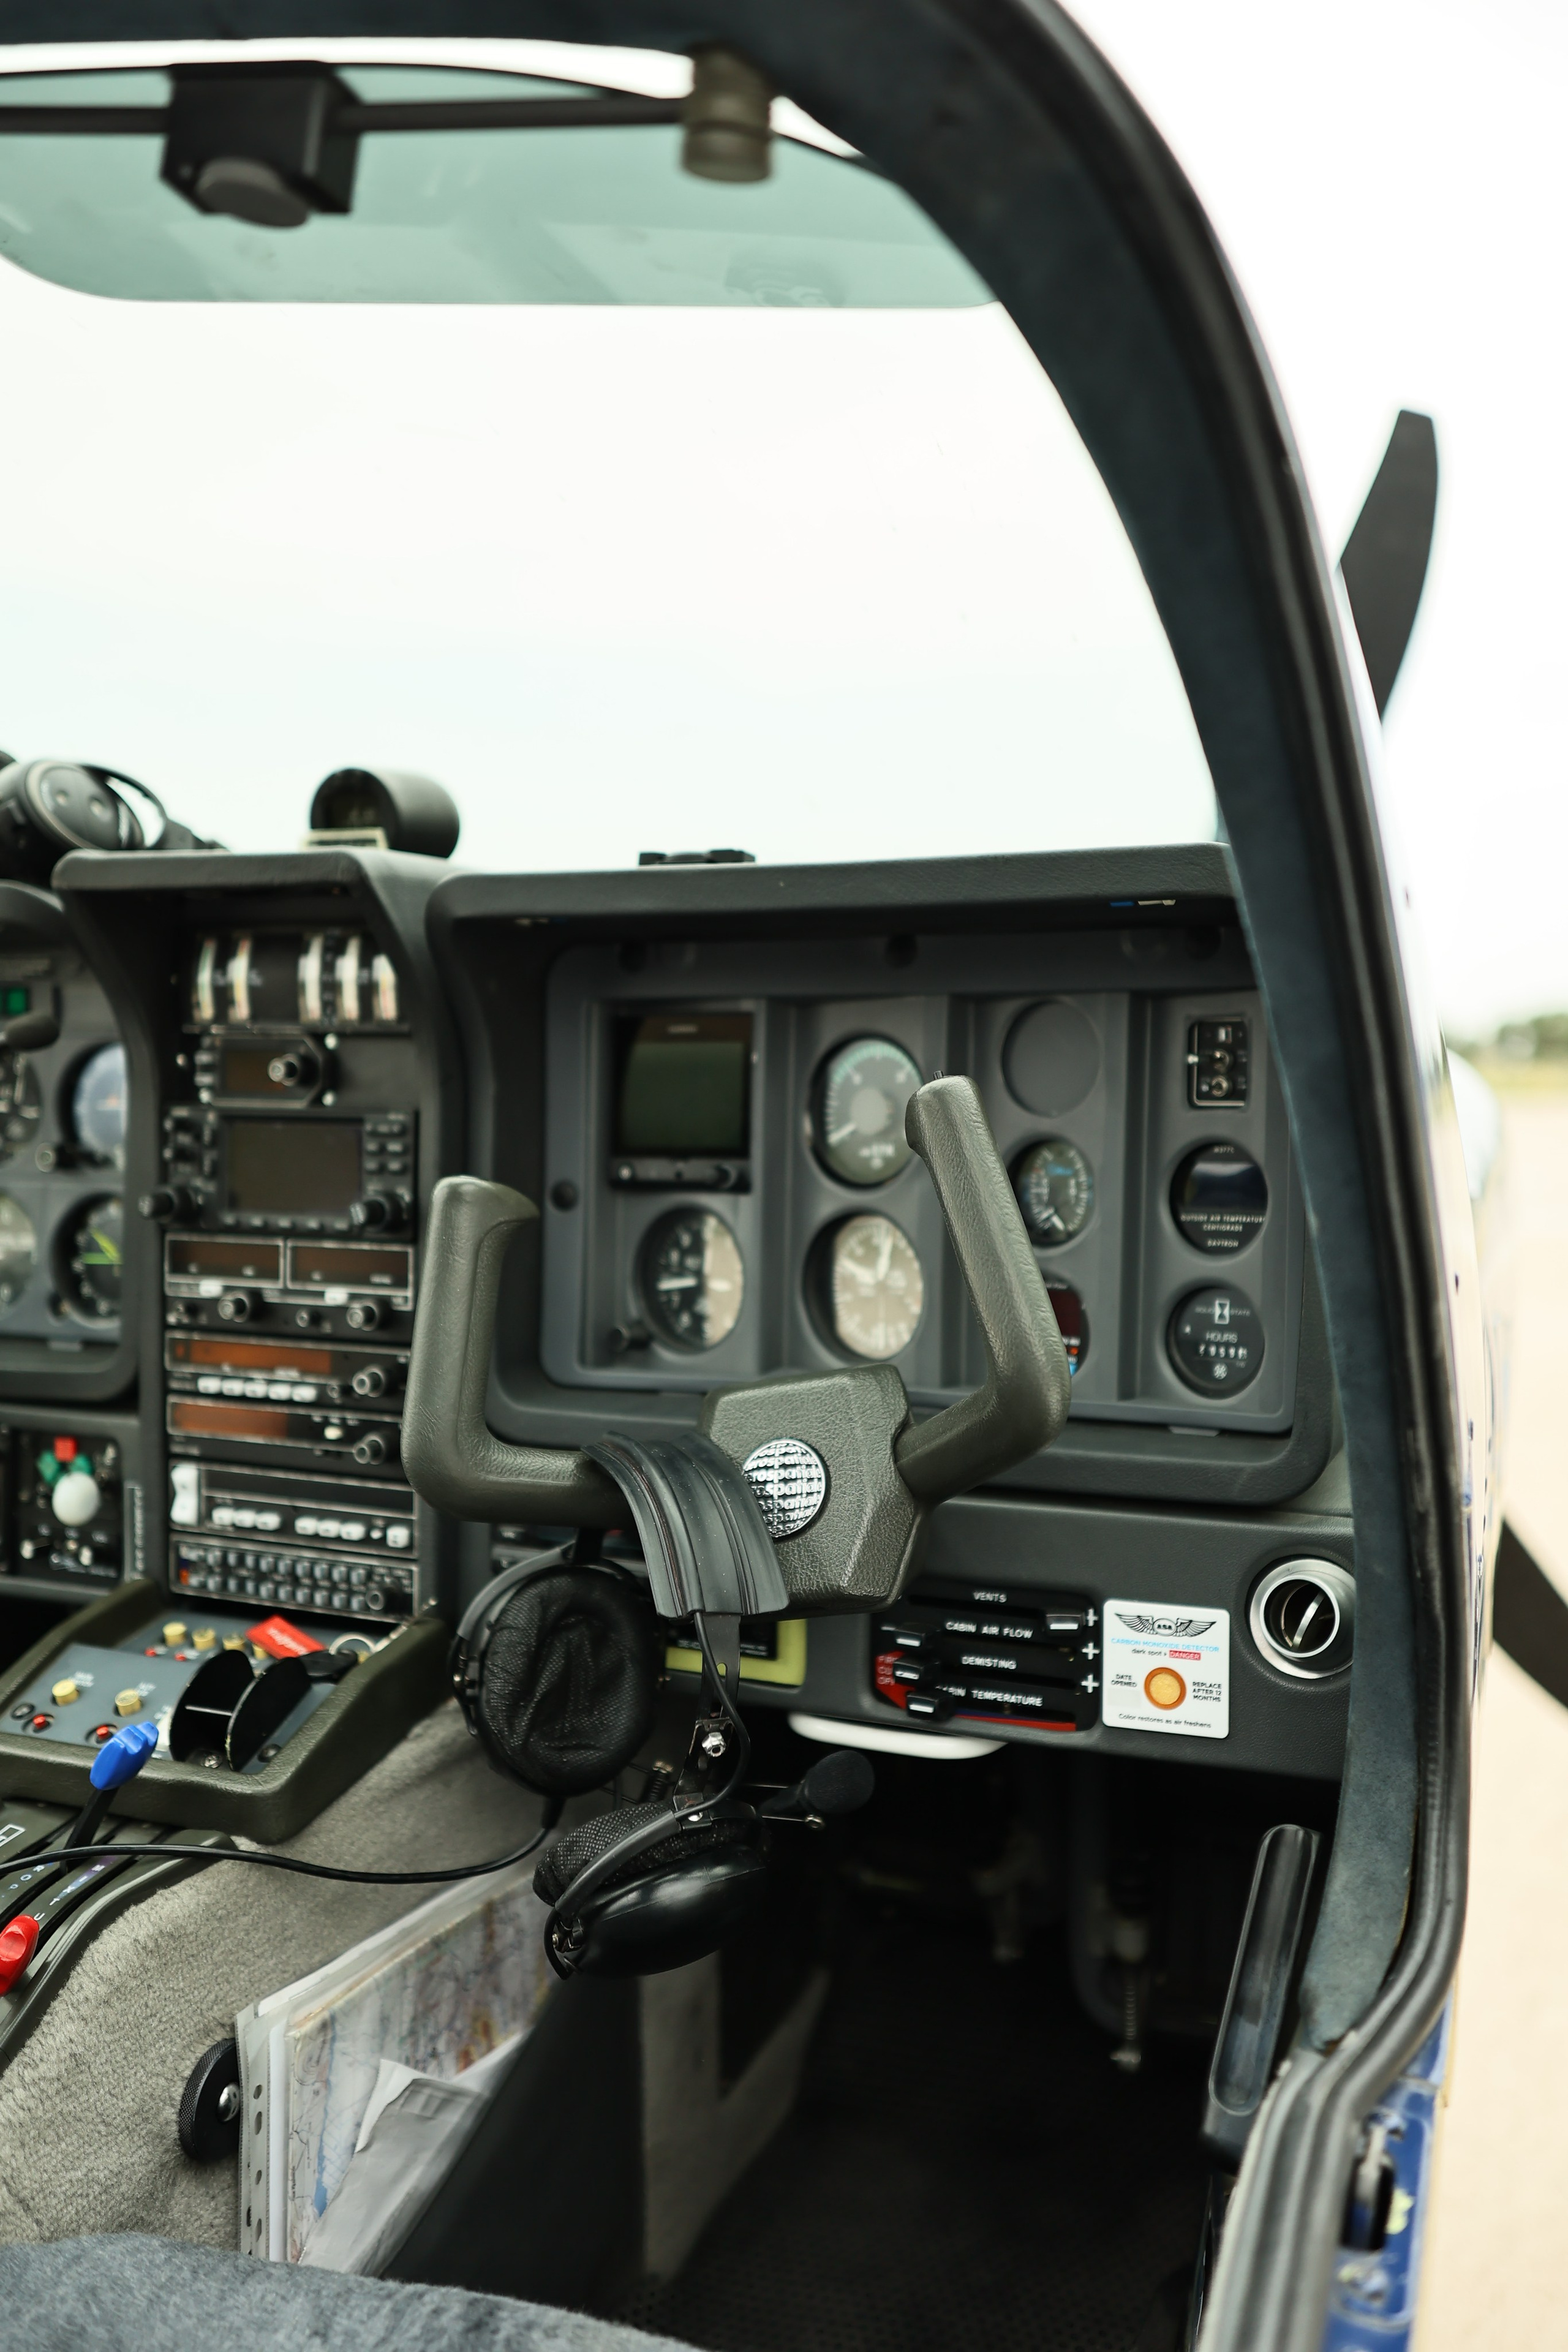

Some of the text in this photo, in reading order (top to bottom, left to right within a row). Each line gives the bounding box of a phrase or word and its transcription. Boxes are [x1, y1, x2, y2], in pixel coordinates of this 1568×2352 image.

[1181, 1213, 1208, 1222] OUTSIDE
[1205, 1331, 1238, 1344] HOURS
[973, 1591, 1007, 1602] VENTS
[945, 1621, 1033, 1638] CABIN AIR FLOW
[1111, 1638, 1140, 1646] CARBON
[1142, 1640, 1180, 1649] MONOXIDE
[1169, 1651, 1200, 1660] DANGER
[961, 1656, 1017, 1670] DEMISTING
[971, 1689, 1043, 1706] TEMPERATURE
[34, 1864, 105, 1921] MIXTU
